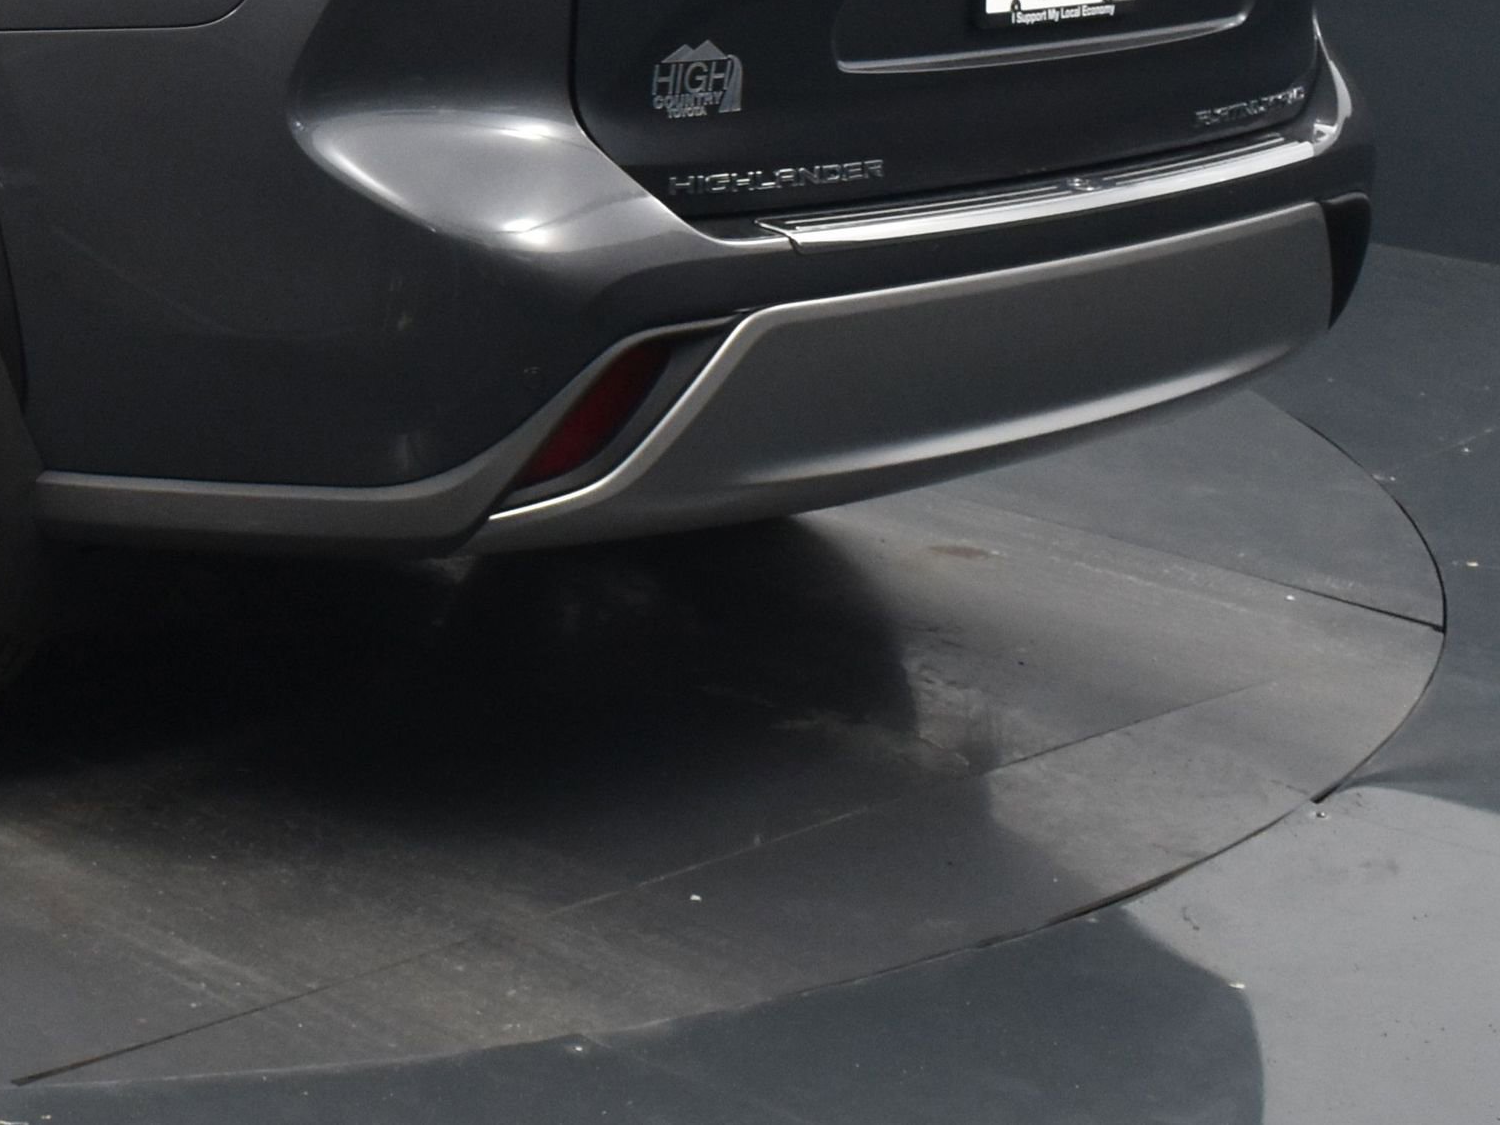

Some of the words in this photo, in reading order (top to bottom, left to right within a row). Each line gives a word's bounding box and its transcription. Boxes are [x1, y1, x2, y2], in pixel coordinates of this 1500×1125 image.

[1016, 10, 1047, 25] Support
[1047, 7, 1060, 23] My
[1060, 6, 1081, 19] Local
[1081, 4, 1116, 17] Economy
[652, 59, 732, 96] HIGH
[652, 90, 723, 110] COUNTRY
[668, 159, 884, 195] HIGHLANDER
